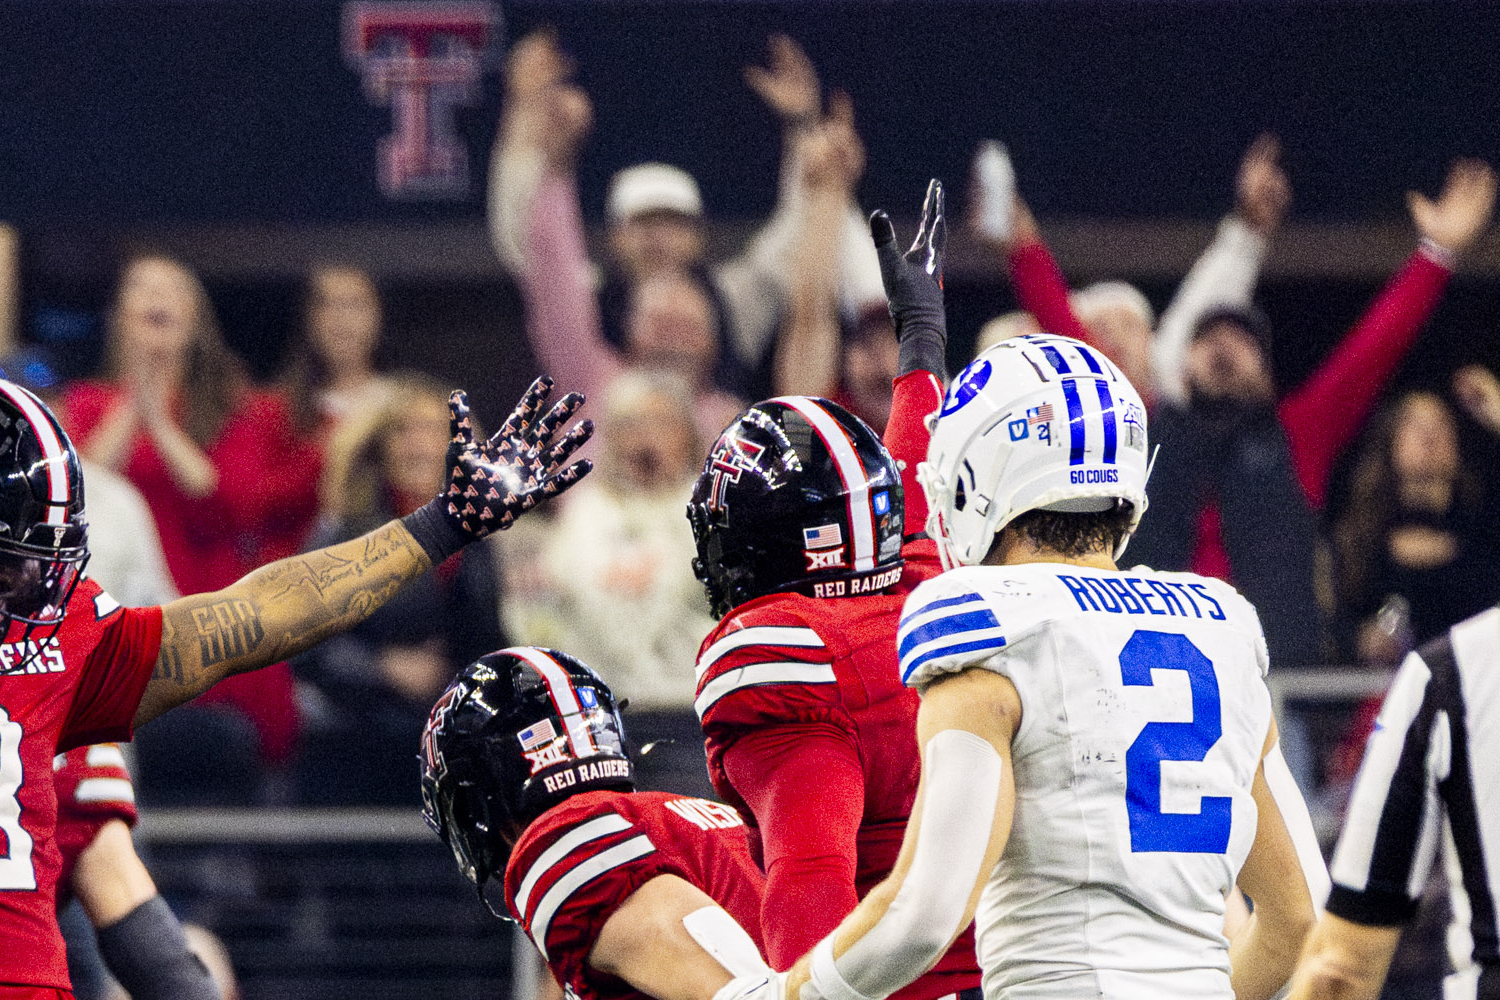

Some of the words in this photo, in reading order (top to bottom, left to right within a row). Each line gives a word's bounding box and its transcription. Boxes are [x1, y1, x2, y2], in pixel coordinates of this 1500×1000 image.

[1070, 470, 1085, 484] GO
[1086, 469, 1119, 483] COUGS
[813, 580, 846, 599] RED
[850, 566, 903, 595] RAIDERS
[1055, 574, 1227, 621] ROBERTS
[1117, 628, 1234, 855] 2
[543, 769, 576, 793] RED
[580, 759, 630, 782] RAIDERS
